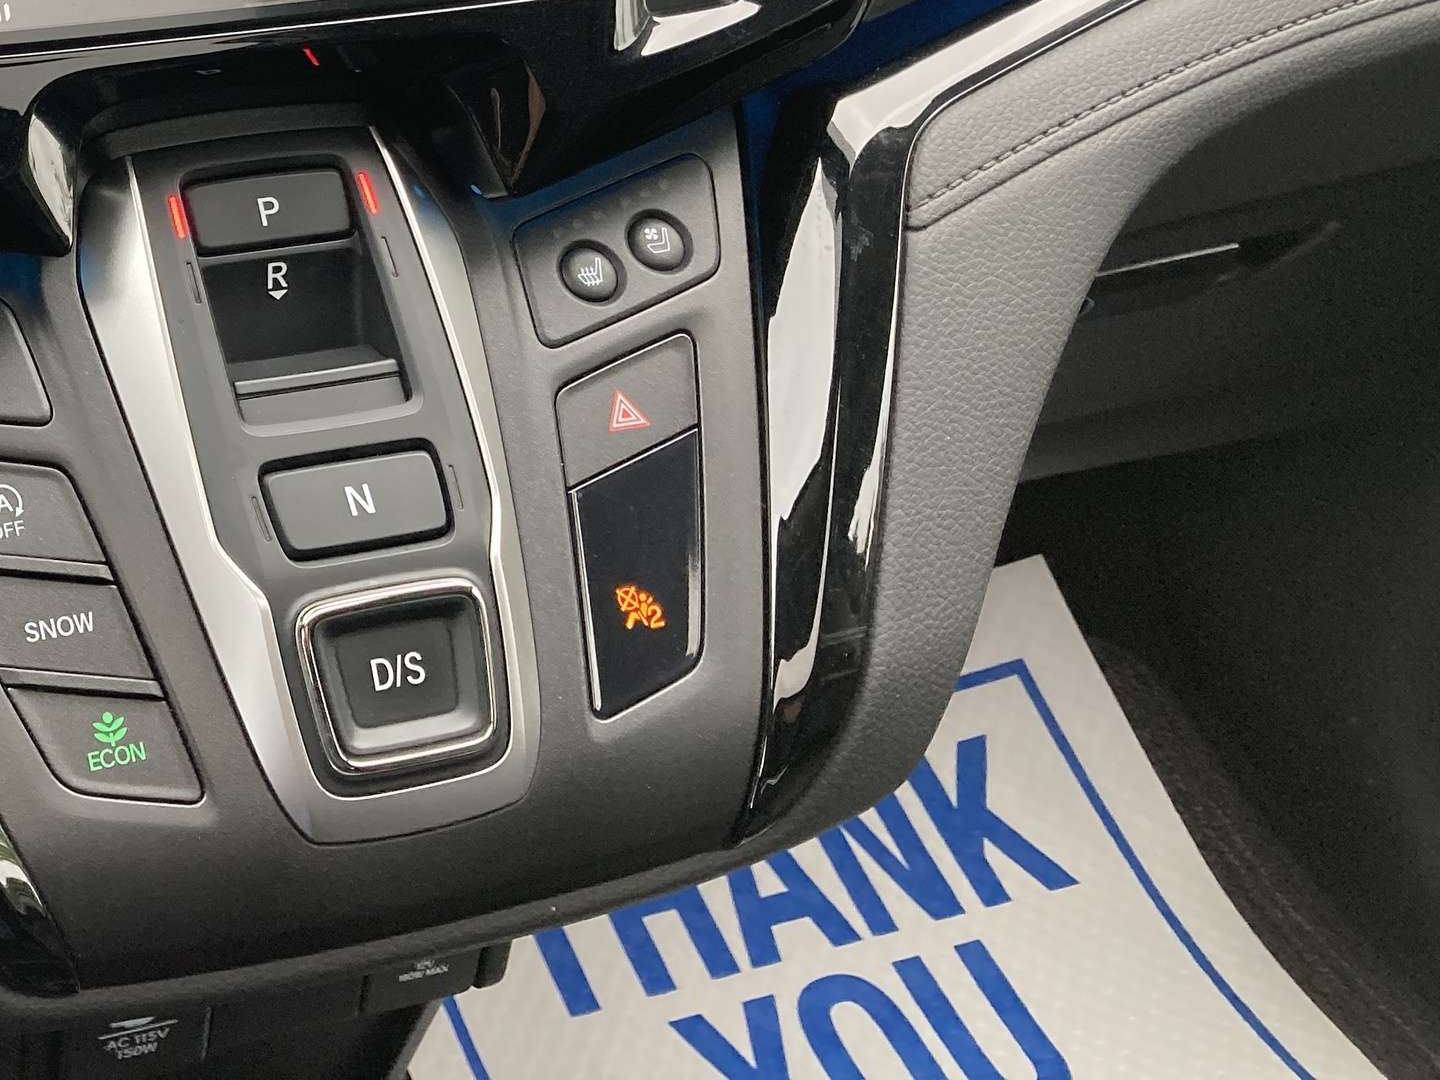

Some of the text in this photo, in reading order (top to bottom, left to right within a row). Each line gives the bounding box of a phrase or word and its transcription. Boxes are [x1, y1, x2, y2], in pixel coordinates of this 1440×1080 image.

[257, 197, 280, 227] P
[266, 262, 289, 289] R
[344, 483, 376, 516] N
[24, 611, 95, 643] SNOW
[370, 651, 426, 692] D/S
[87, 742, 146, 771] ECON
[103, 1037, 131, 1051] AC
